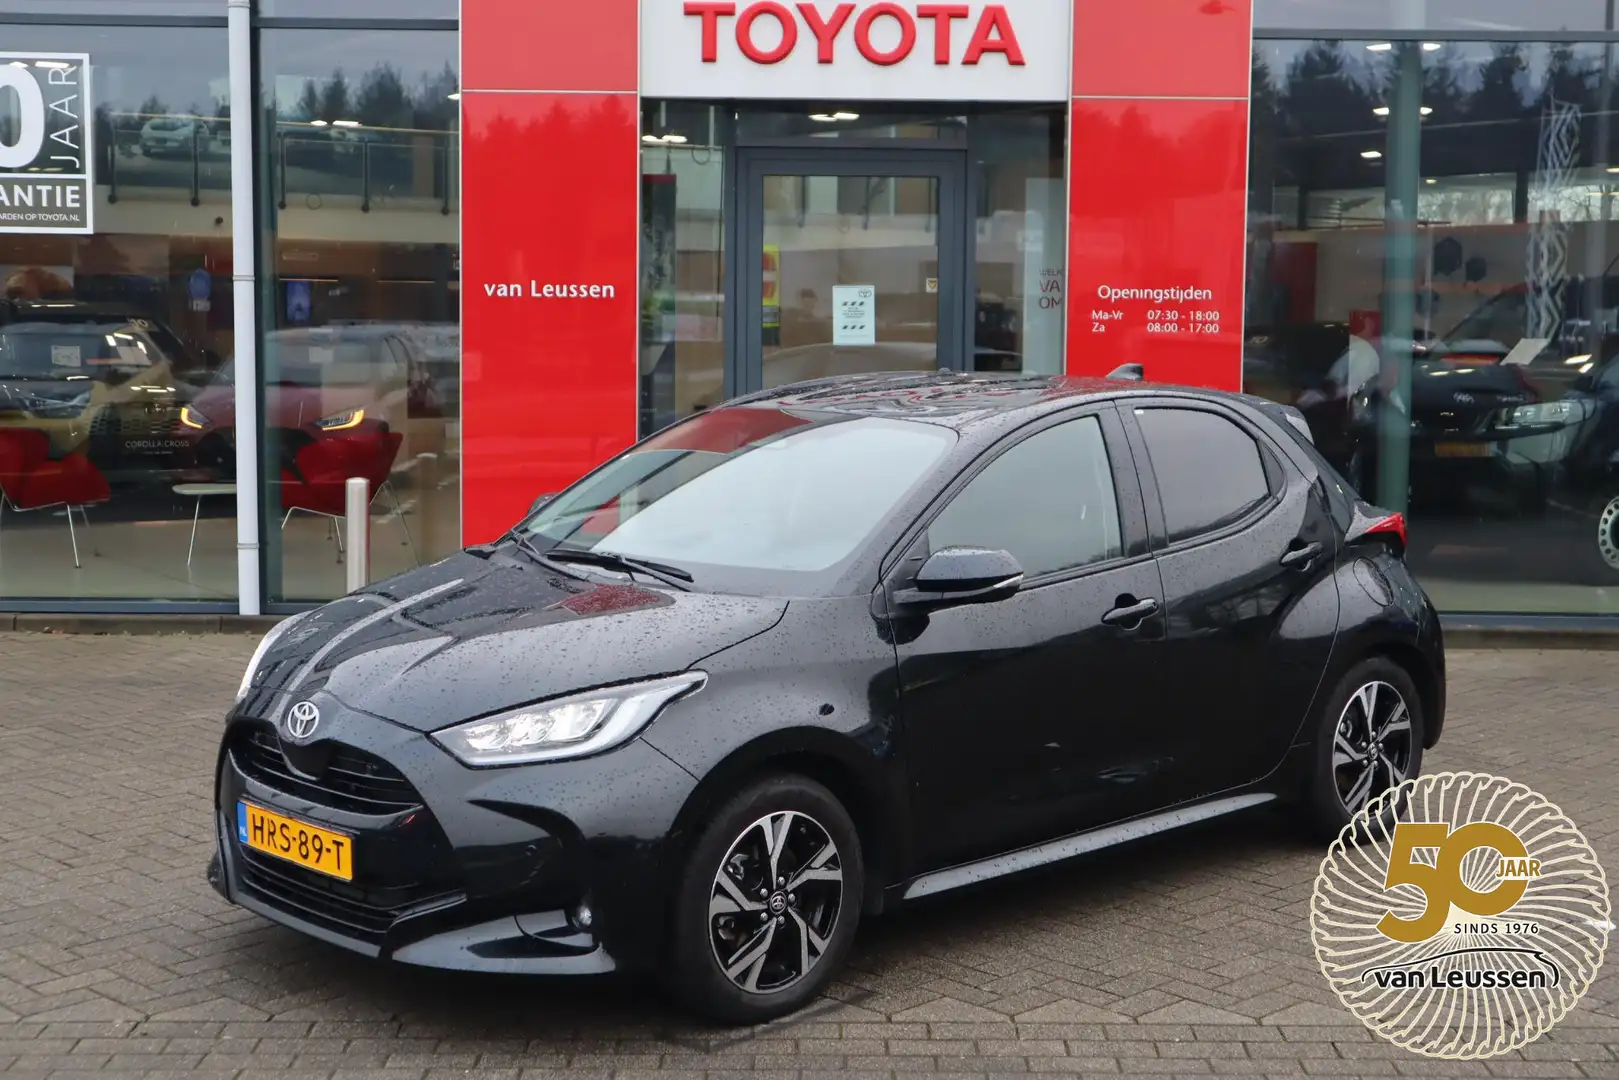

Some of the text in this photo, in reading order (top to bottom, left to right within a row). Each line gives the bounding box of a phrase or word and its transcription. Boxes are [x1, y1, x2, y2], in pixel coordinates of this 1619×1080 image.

[683, 0, 1026, 66] TOYOTA
[48, 65, 80, 169] JAAR
[25, 213, 37, 221] OP
[38, 213, 80, 222] TOYOTA.NL
[483, 279, 615, 298] van Leussen
[1097, 284, 1212, 303] Openingstijden
[1091, 309, 1124, 321] Ma-Vr
[1147, 310, 1179, 321] 07:30
[1189, 310, 1220, 321] 18:00
[1091, 322, 1106, 333] Za
[1147, 322, 1179, 333] 08:00
[1189, 323, 1220, 334] 17:00
[251, 812, 345, 872] HRS-89-T
